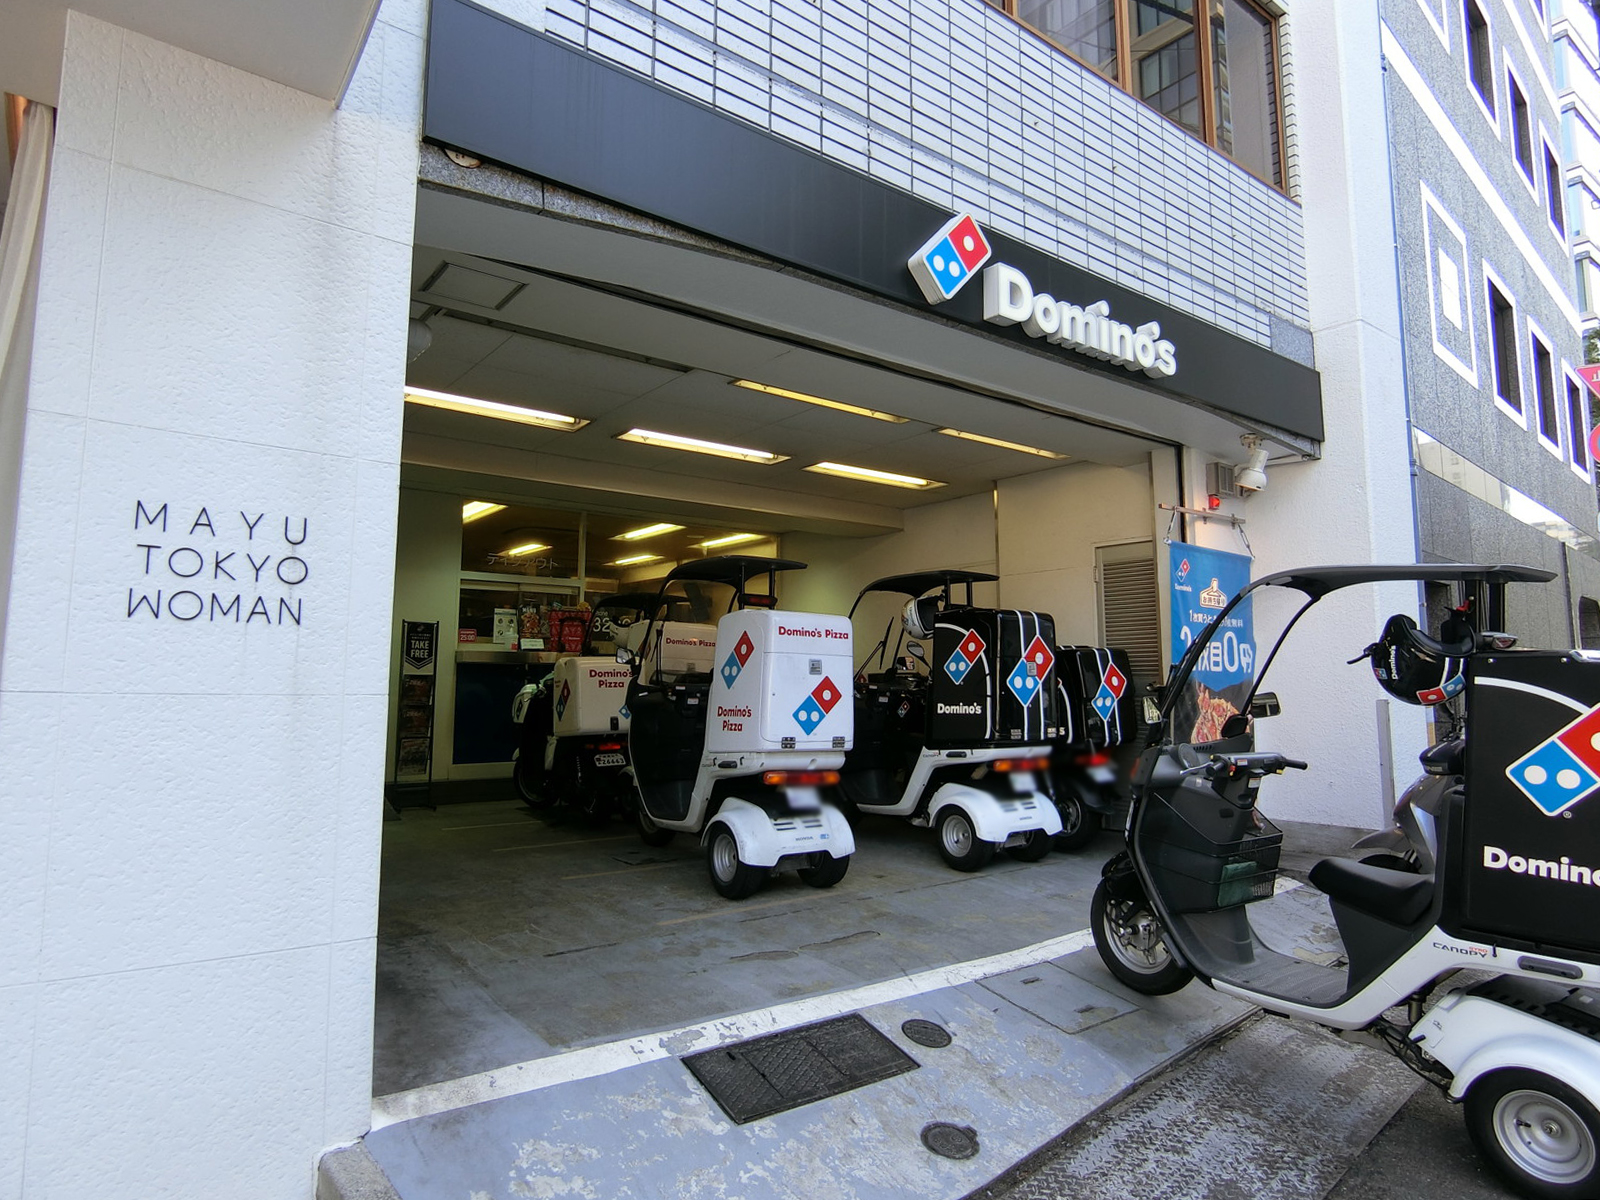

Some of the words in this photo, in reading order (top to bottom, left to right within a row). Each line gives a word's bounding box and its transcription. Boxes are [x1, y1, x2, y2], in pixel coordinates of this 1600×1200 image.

[983, 261, 1178, 379] Domino's
[134, 499, 308, 545] MAYU
[136, 543, 309, 585] TOKYO
[127, 587, 302, 626] WOMAN
[778, 626, 822, 638] Domino's
[825, 629, 849, 640] Pizza
[410, 640, 430, 649] TAKE
[665, 637, 697, 646] Domino's
[410, 649, 430, 659] FREE
[589, 668, 634, 678] Domino's
[598, 679, 625, 688] Pizza
[717, 705, 752, 718] Domino's
[937, 702, 983, 715] Domino's
[722, 720, 743, 732] Pizza
[1433, 942, 1487, 958] CANOPY
